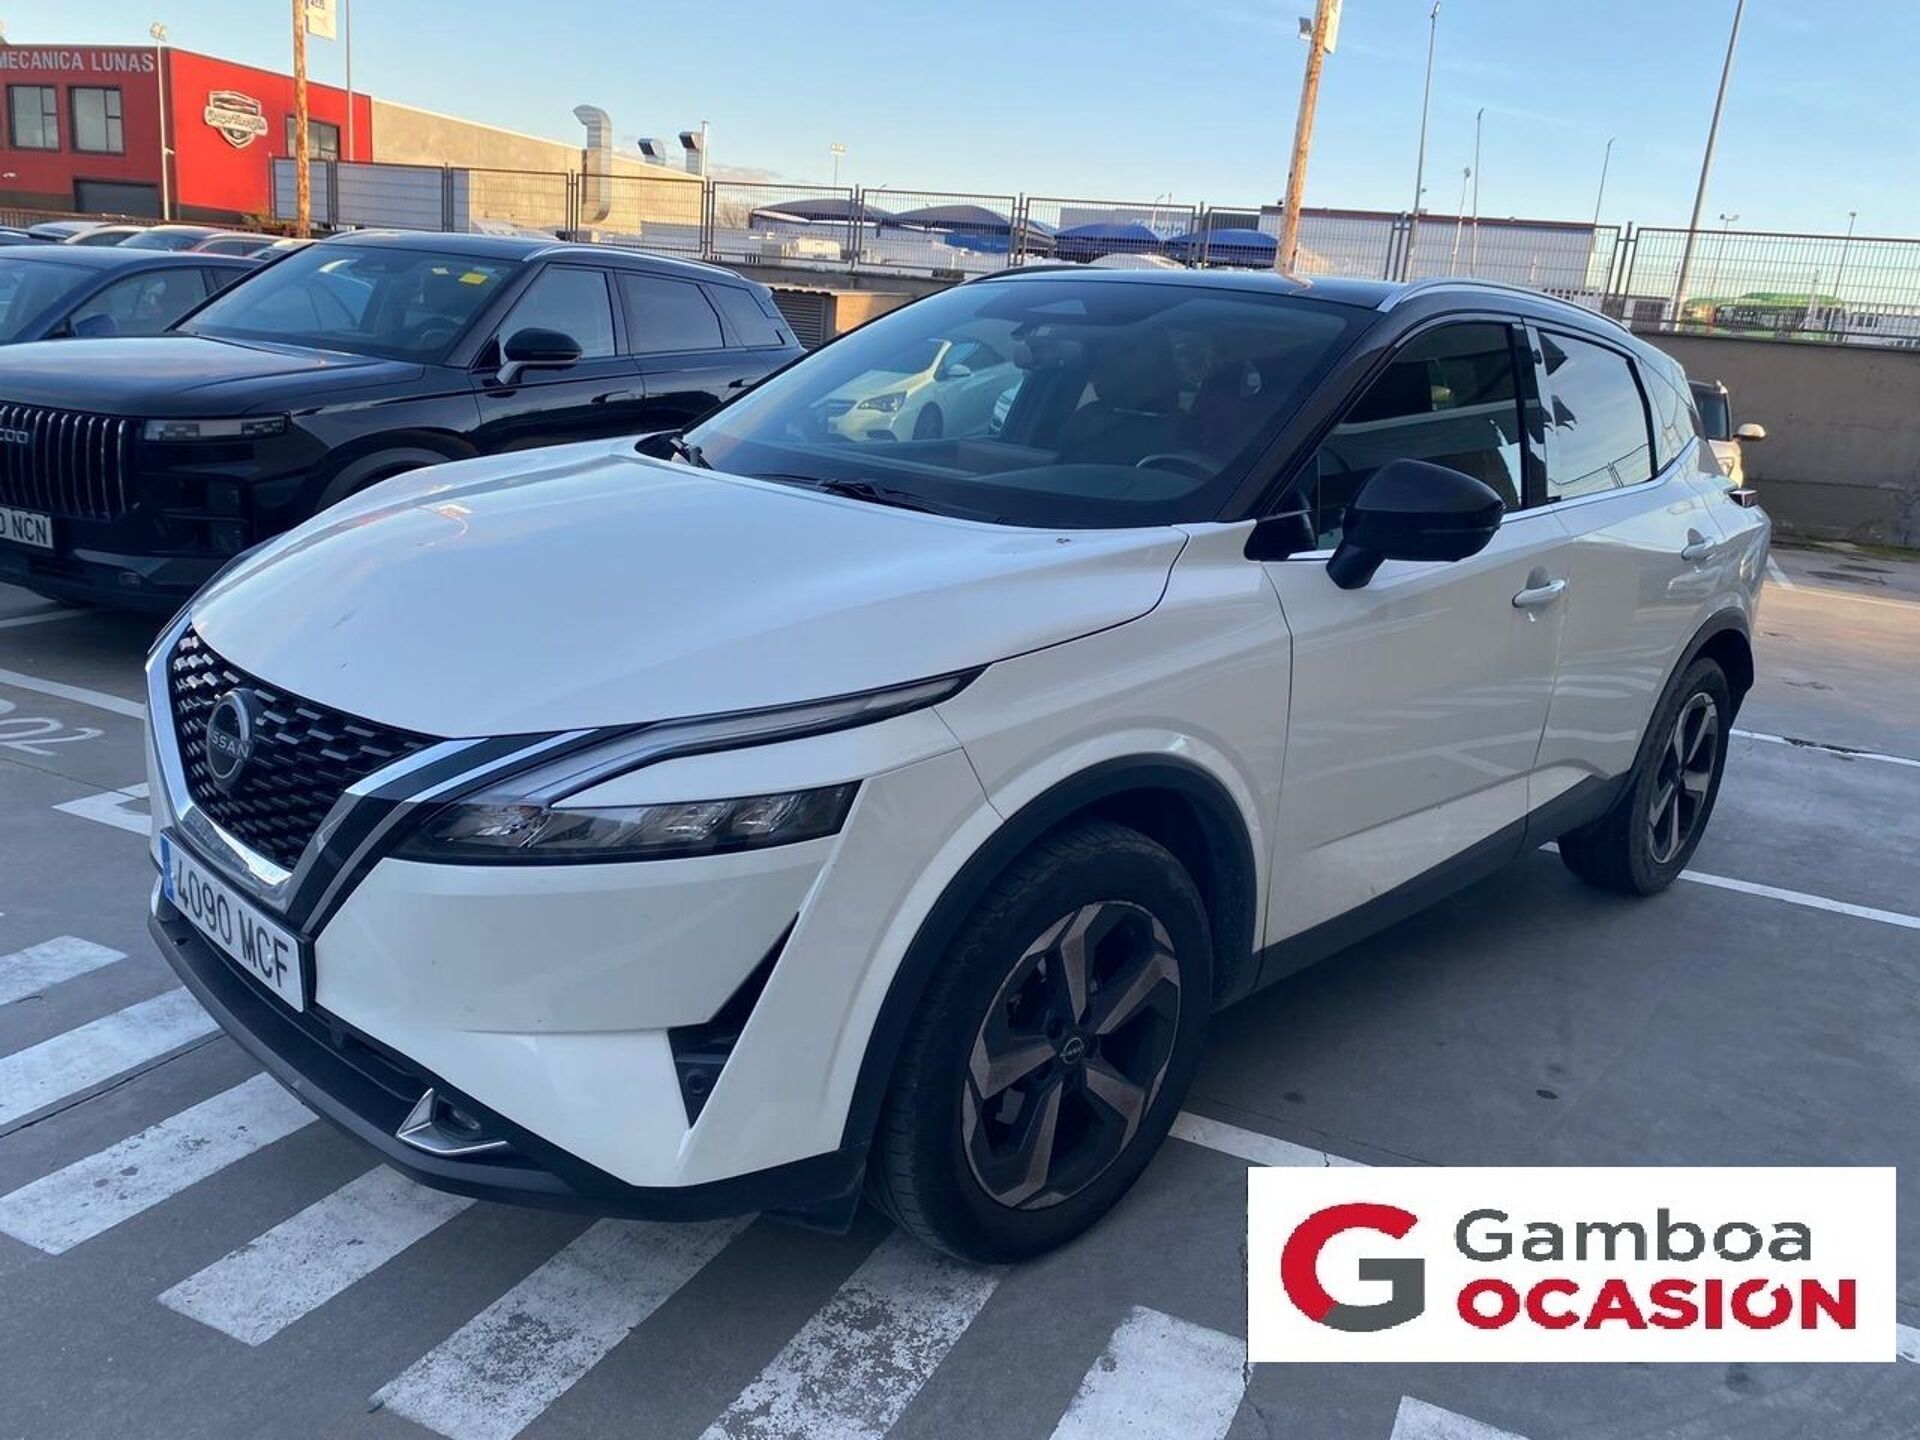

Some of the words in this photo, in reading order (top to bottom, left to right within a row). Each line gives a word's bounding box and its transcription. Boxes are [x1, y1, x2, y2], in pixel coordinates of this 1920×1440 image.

[91, 51, 155, 72] LUNAS
[12, 514, 48, 546] NCN
[177, 861, 232, 946] 4090
[238, 909, 289, 988] MCF
